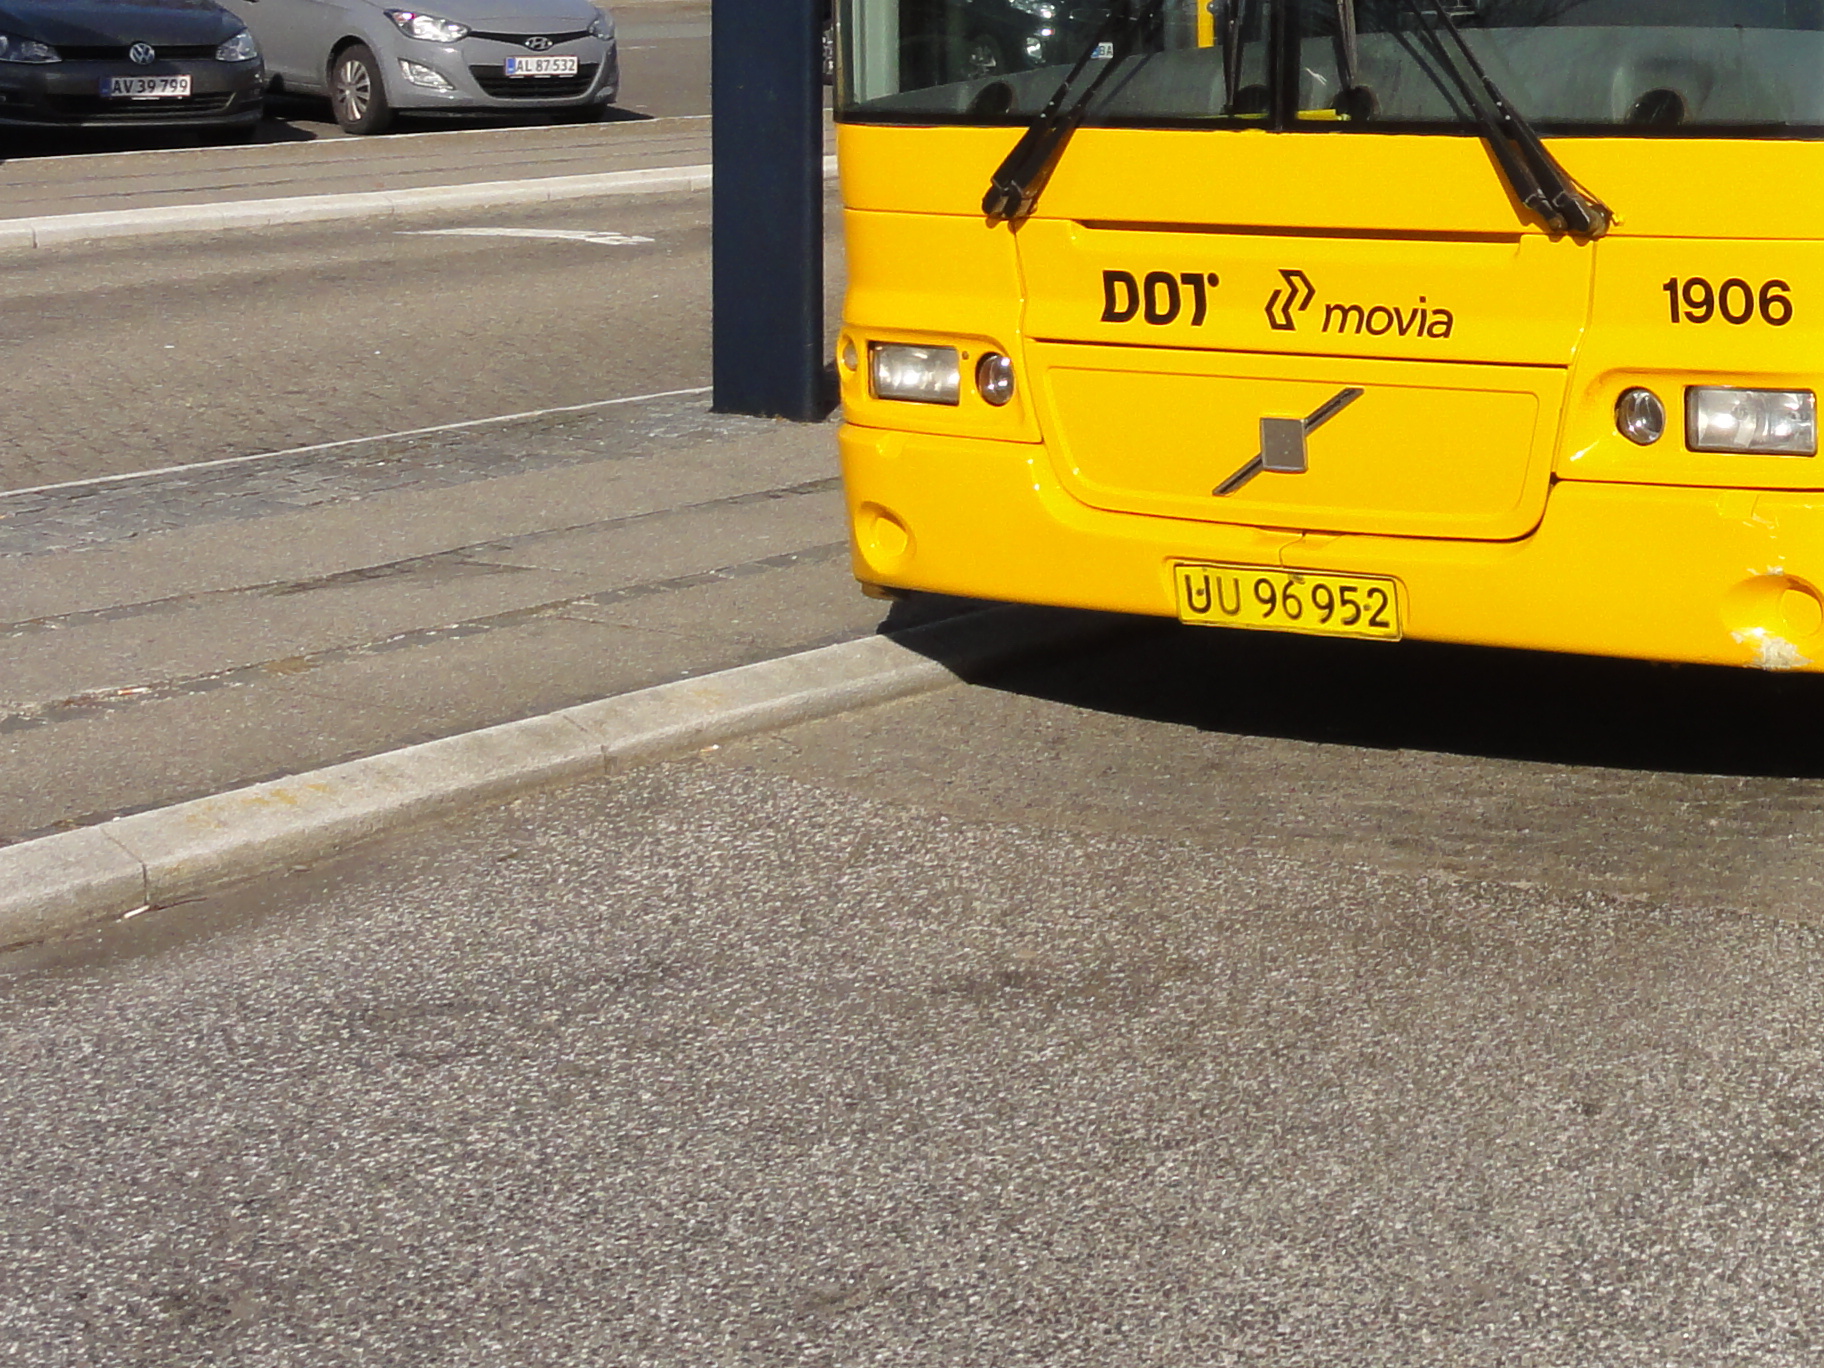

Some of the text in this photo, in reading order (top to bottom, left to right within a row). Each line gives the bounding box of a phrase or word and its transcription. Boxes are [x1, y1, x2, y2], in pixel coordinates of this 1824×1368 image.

[113, 78, 188, 94] AV 39 799
[516, 59, 575, 72] AL 87 532
[1100, 270, 1211, 327] DOT
[1321, 295, 1455, 339] movia
[1662, 275, 1793, 326] 1906
[1184, 573, 1391, 629] UU 96 952
